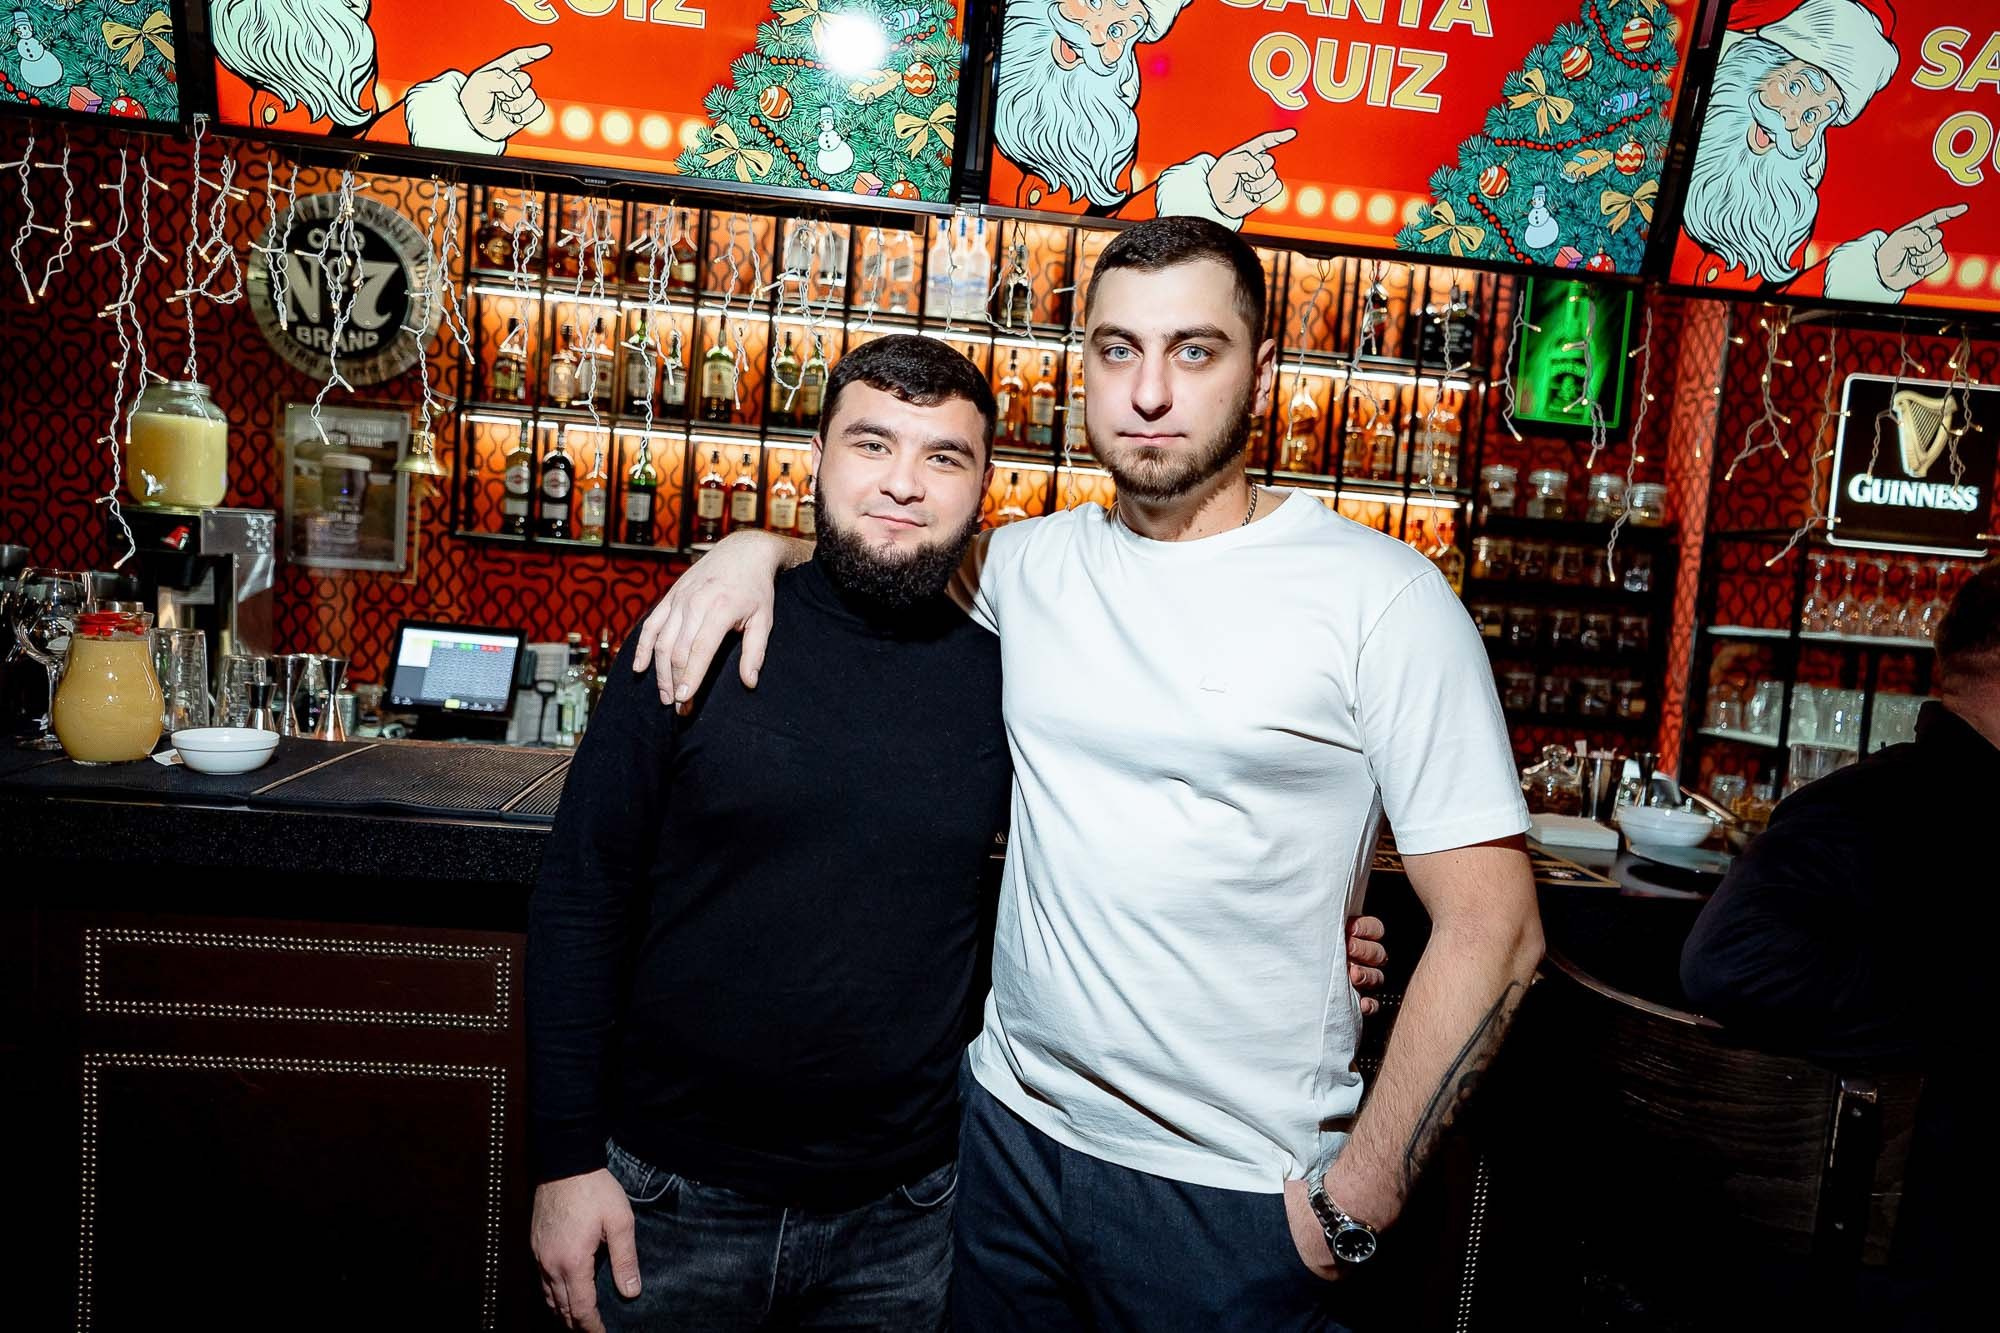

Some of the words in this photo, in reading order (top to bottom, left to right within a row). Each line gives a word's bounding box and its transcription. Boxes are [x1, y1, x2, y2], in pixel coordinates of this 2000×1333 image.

[1249, 31, 1447, 113] QUIZ
[307, 227, 366, 251] OLD
[296, 326, 380, 353] BRAND
[1848, 473, 1980, 512] GUINNESS
